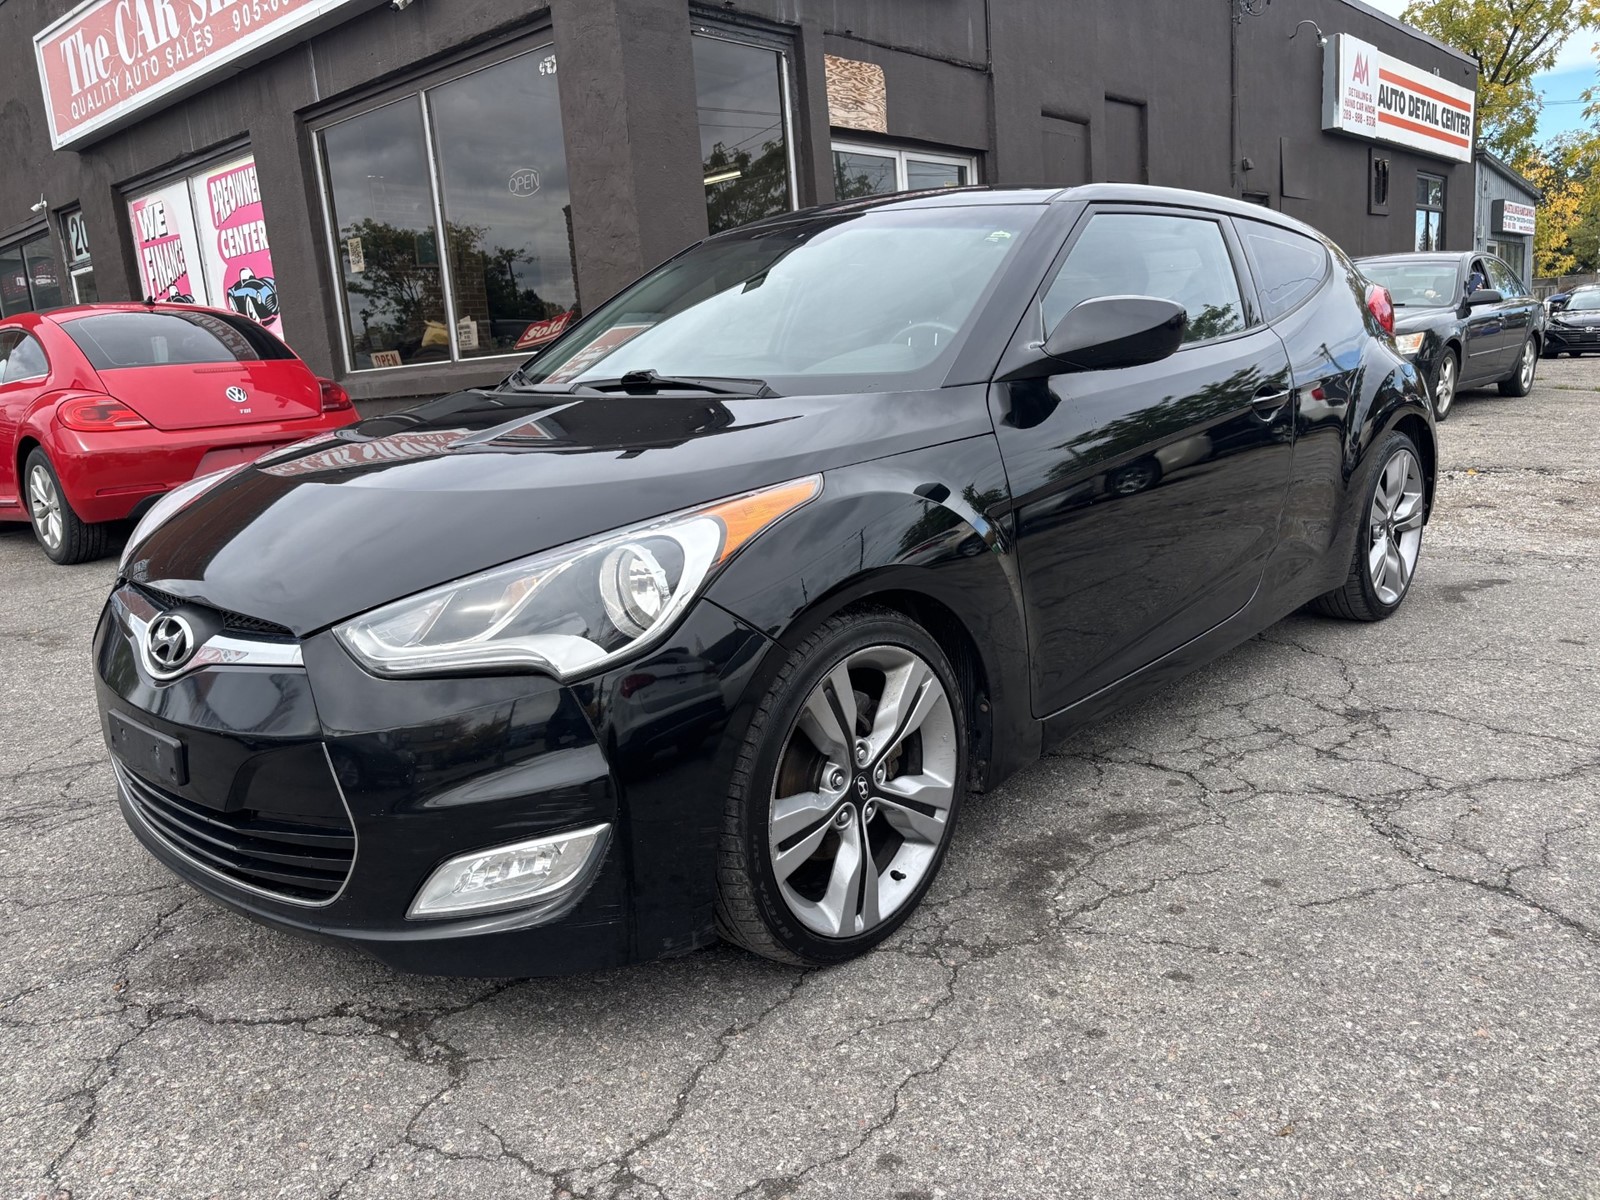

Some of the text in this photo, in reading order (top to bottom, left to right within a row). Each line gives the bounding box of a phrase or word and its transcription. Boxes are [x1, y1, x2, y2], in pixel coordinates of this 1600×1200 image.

[60, 28, 112, 96] The
[114, 0, 181, 65] CAR
[71, 75, 119, 120] QUALITY
[125, 55, 159, 91] AUTO
[165, 25, 213, 68] SALES
[1356, 101, 1364, 111] CAR
[1377, 83, 1471, 136] AUTO DETAIL CENTER
[508, 172, 540, 193] OPEN
[136, 201, 168, 242] WE
[220, 219, 270, 259] CENTER
[523, 316, 568, 341] Sold
[374, 352, 399, 367] OPEN
